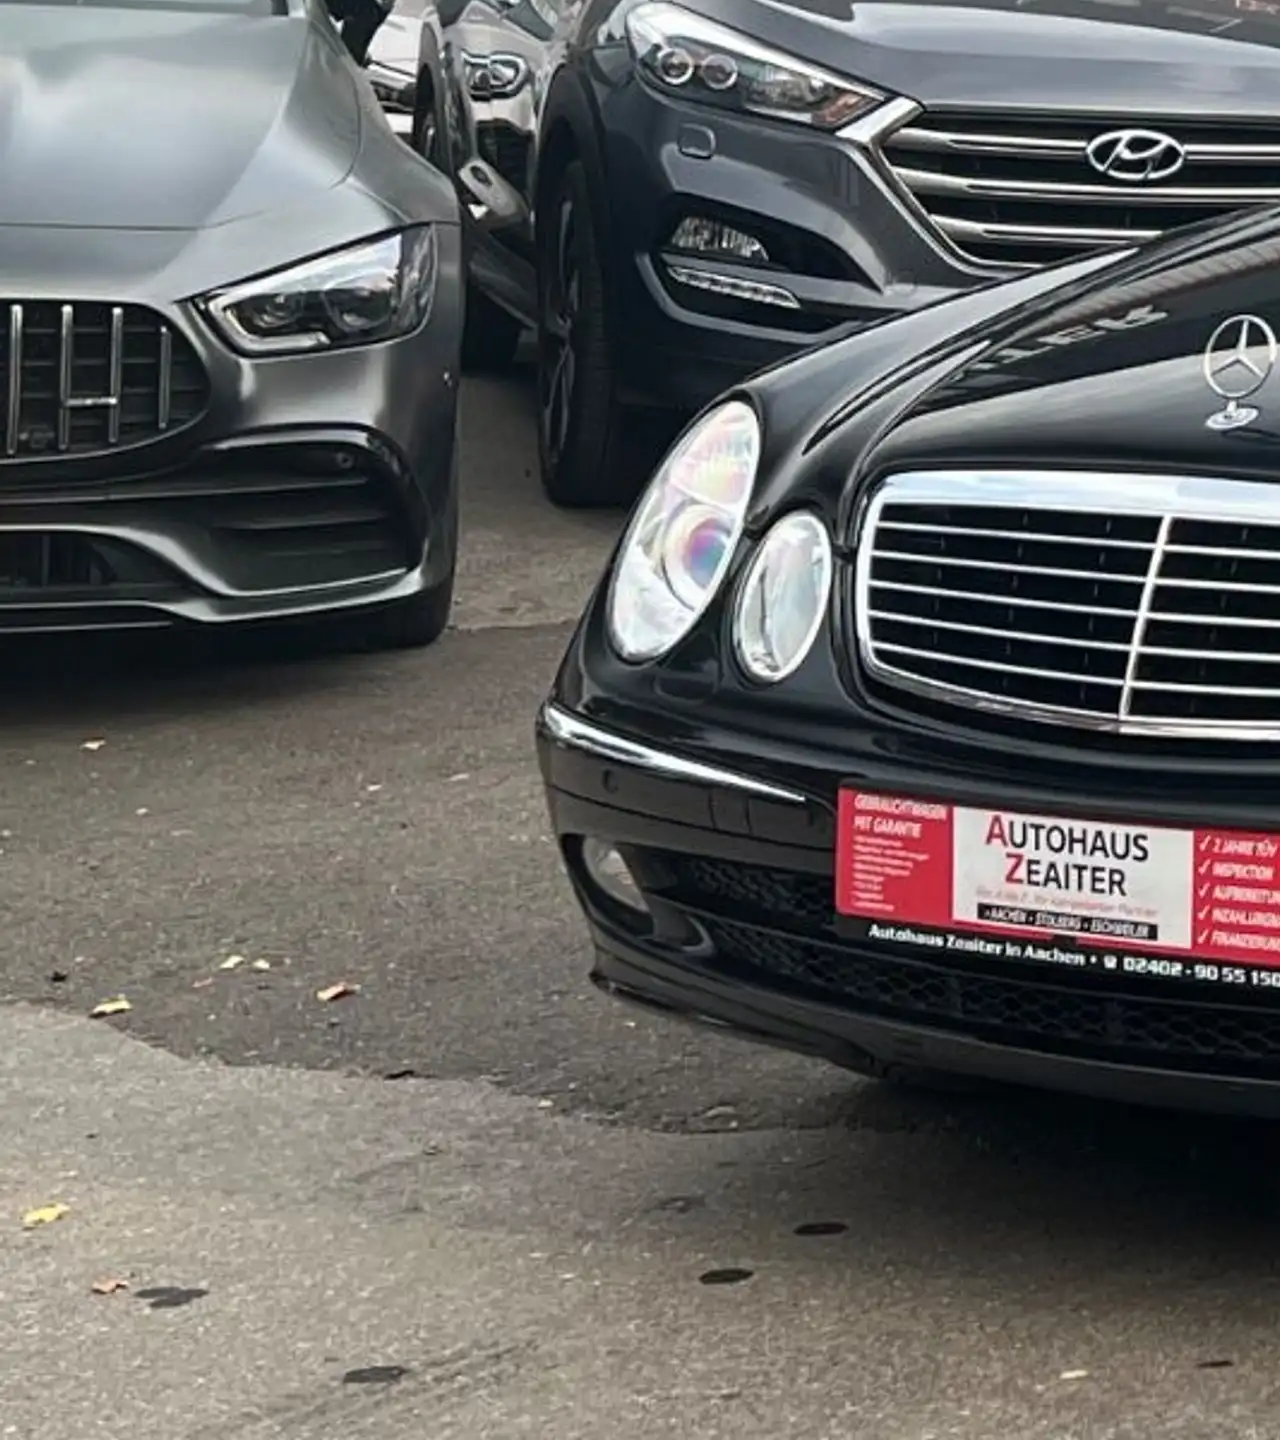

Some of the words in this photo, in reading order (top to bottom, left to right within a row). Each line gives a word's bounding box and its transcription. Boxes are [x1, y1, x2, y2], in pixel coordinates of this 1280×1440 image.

[985, 813, 1150, 862] AUTOHAUS
[1004, 852, 1127, 897] ZEAITER
[868, 923, 945, 948] Autohaus
[946, 933, 1004, 957] Zeaiter
[1005, 942, 1021, 958] in
[1022, 945, 1086, 966] Aachen
[1123, 956, 1184, 977] 02402
[1194, 963, 1218, 982] 90
[1221, 967, 1247, 984] 55
